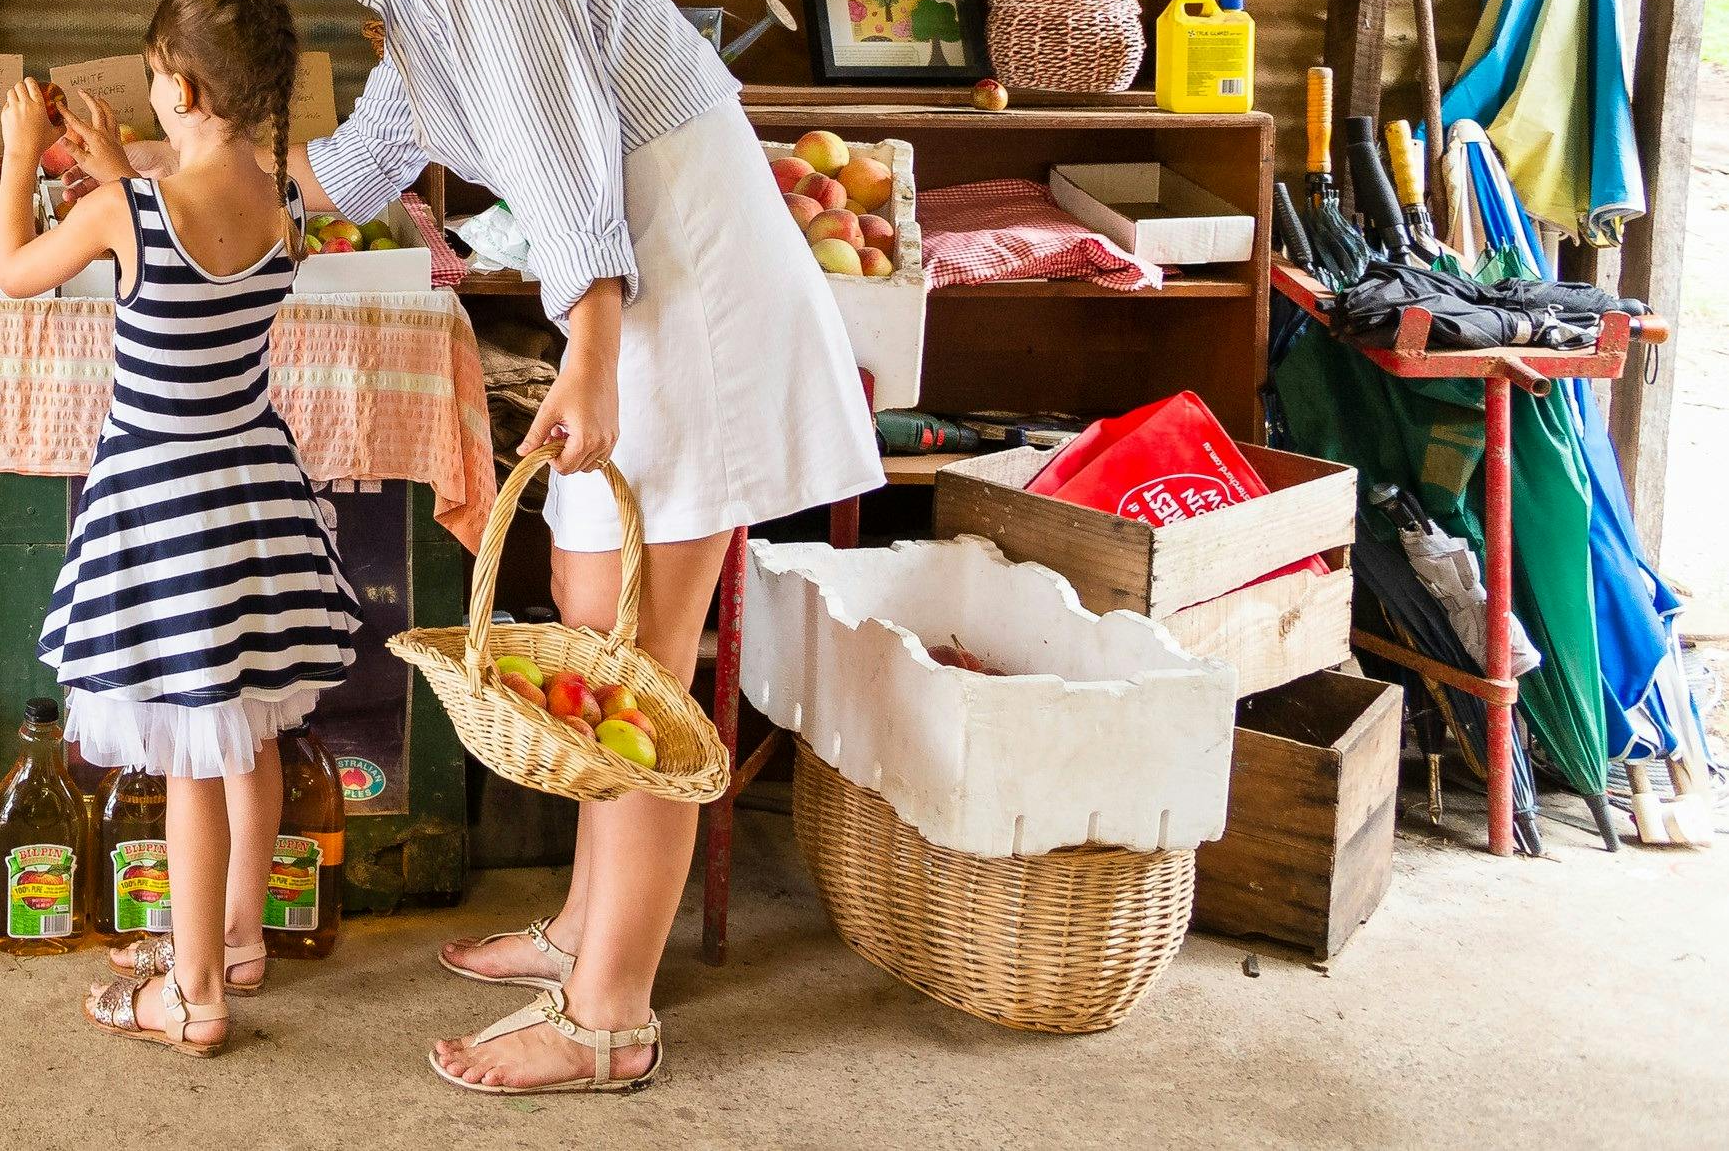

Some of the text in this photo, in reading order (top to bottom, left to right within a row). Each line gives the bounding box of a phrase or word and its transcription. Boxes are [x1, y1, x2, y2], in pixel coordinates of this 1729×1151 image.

[70, 71, 105, 87] WHITE
[124, 842, 168, 854] BILPIN
[275, 837, 310, 851] LPIN
[19, 847, 63, 860] BILPIN
[14, 886, 31, 896] 100%
[31, 884, 44, 893] PURE
[120, 878, 149, 890] 100% PURE
